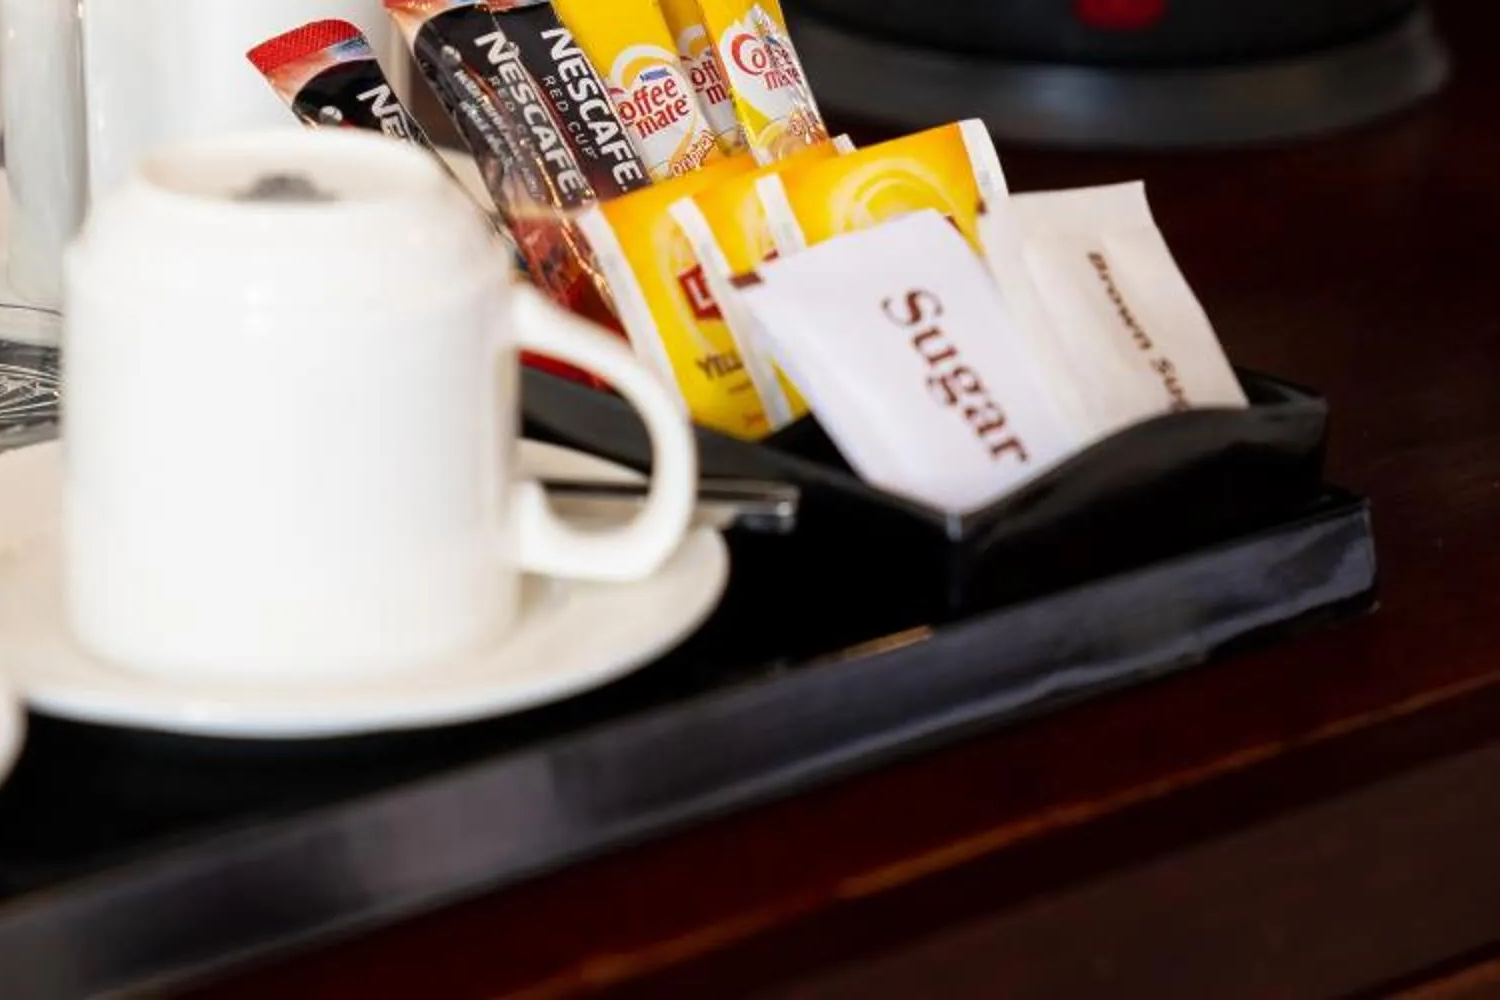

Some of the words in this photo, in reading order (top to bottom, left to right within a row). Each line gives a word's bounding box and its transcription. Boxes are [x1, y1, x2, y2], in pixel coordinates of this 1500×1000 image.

[542, 74, 569, 113] RED
[608, 78, 678, 127] offee
[635, 97, 690, 140] mate
[881, 289, 1029, 463] Sugar
